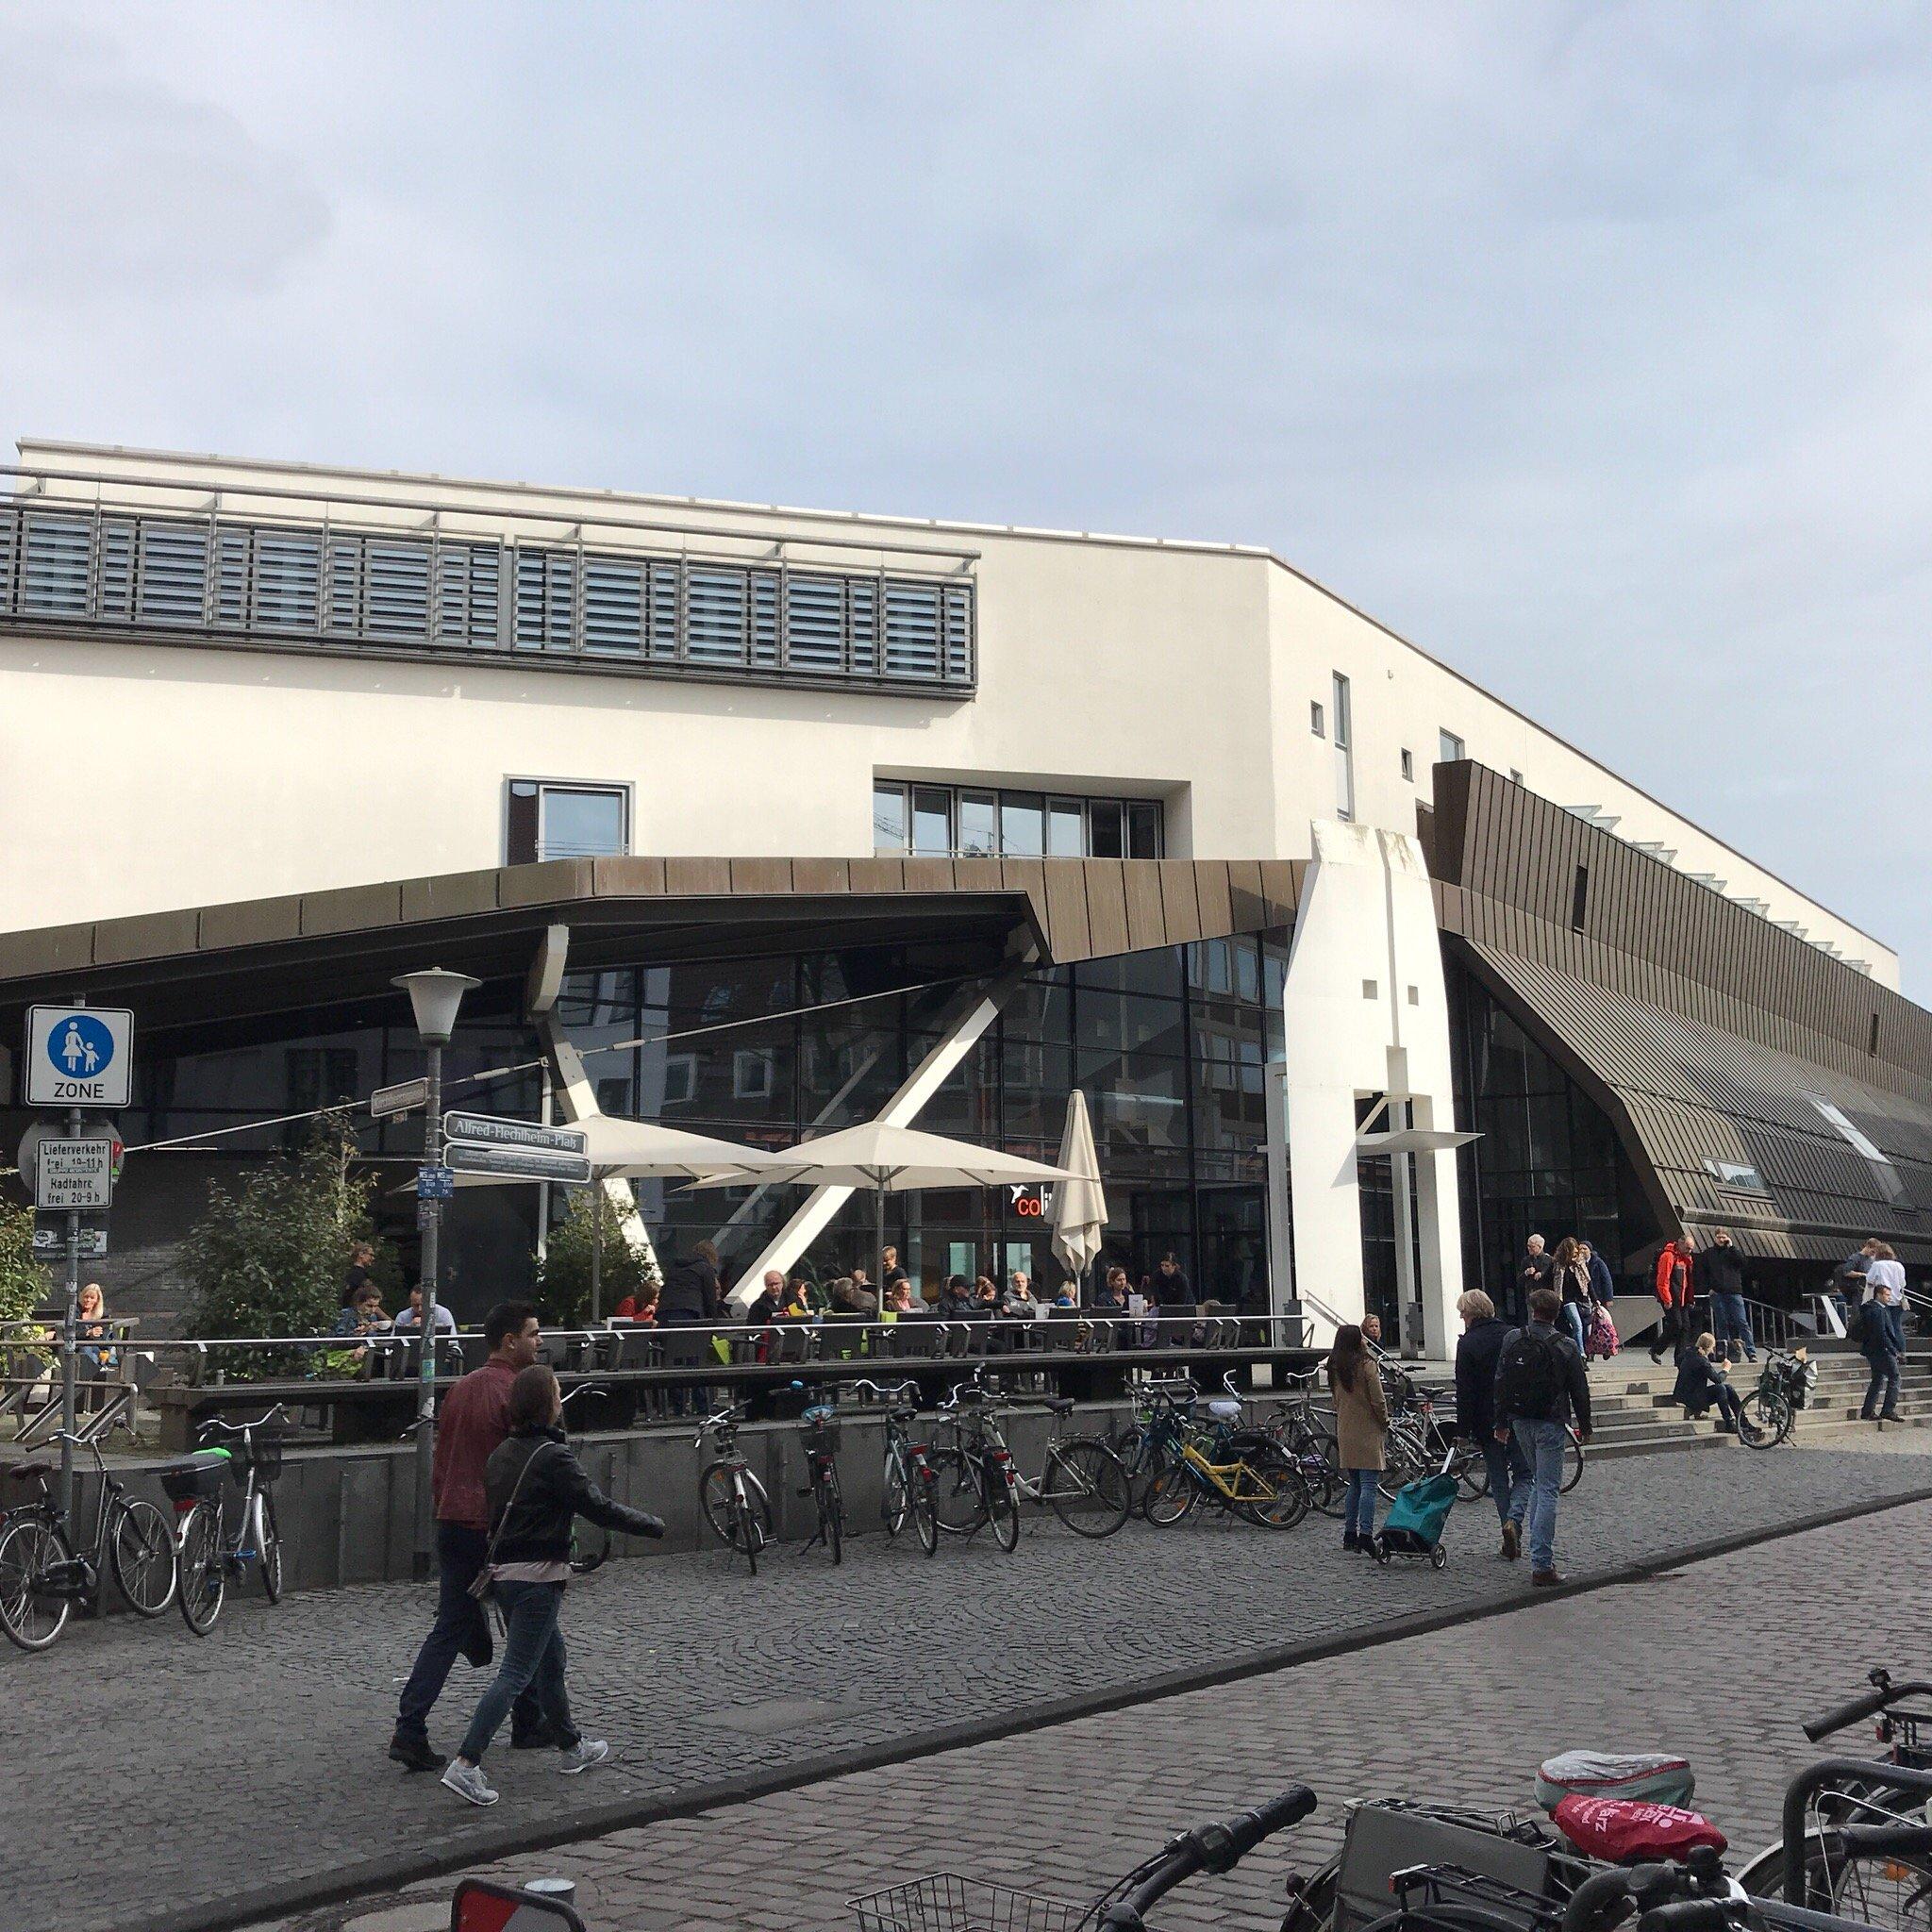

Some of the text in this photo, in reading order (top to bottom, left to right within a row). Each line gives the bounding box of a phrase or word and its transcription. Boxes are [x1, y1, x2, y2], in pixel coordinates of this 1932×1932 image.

[54, 1082, 105, 1099] ZONE
[43, 1143, 106, 1155] Lieferverkehr
[47, 1192, 64, 1204] frei
